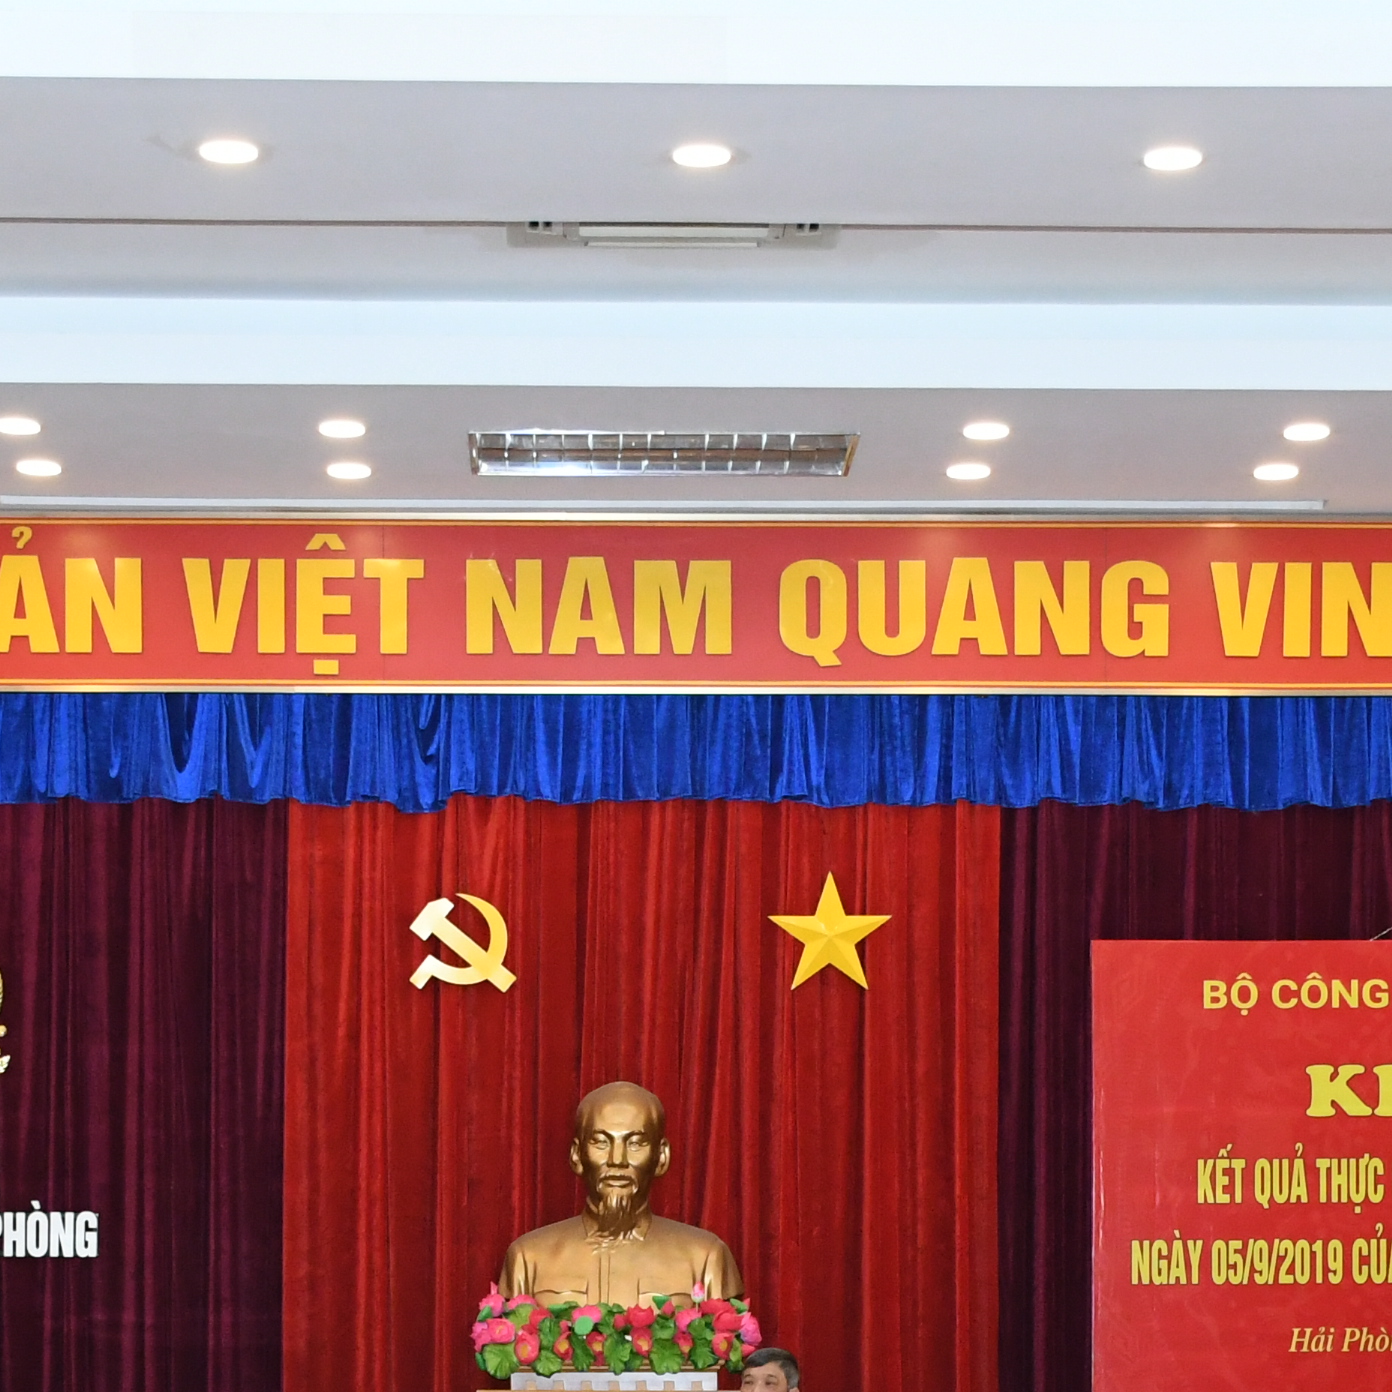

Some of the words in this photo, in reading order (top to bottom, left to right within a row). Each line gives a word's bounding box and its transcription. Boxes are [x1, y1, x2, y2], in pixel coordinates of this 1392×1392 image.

[182, 534, 424, 677] VIỆT
[466, 557, 732, 654] NAM
[779, 557, 1169, 666] QUANG
[1203, 973, 1258, 1015] BỘ
[1272, 972, 1389, 1009] CÔNG
[1198, 1146, 1245, 1203] KẾT
[1255, 1143, 1308, 1209] QUẢ
[1316, 1153, 1384, 1213] THỰC
[1132, 1230, 1203, 1285] NGÀY
[1212, 1239, 1343, 1284] 05/9/2019
[1289, 1327, 1334, 1352] Hải
